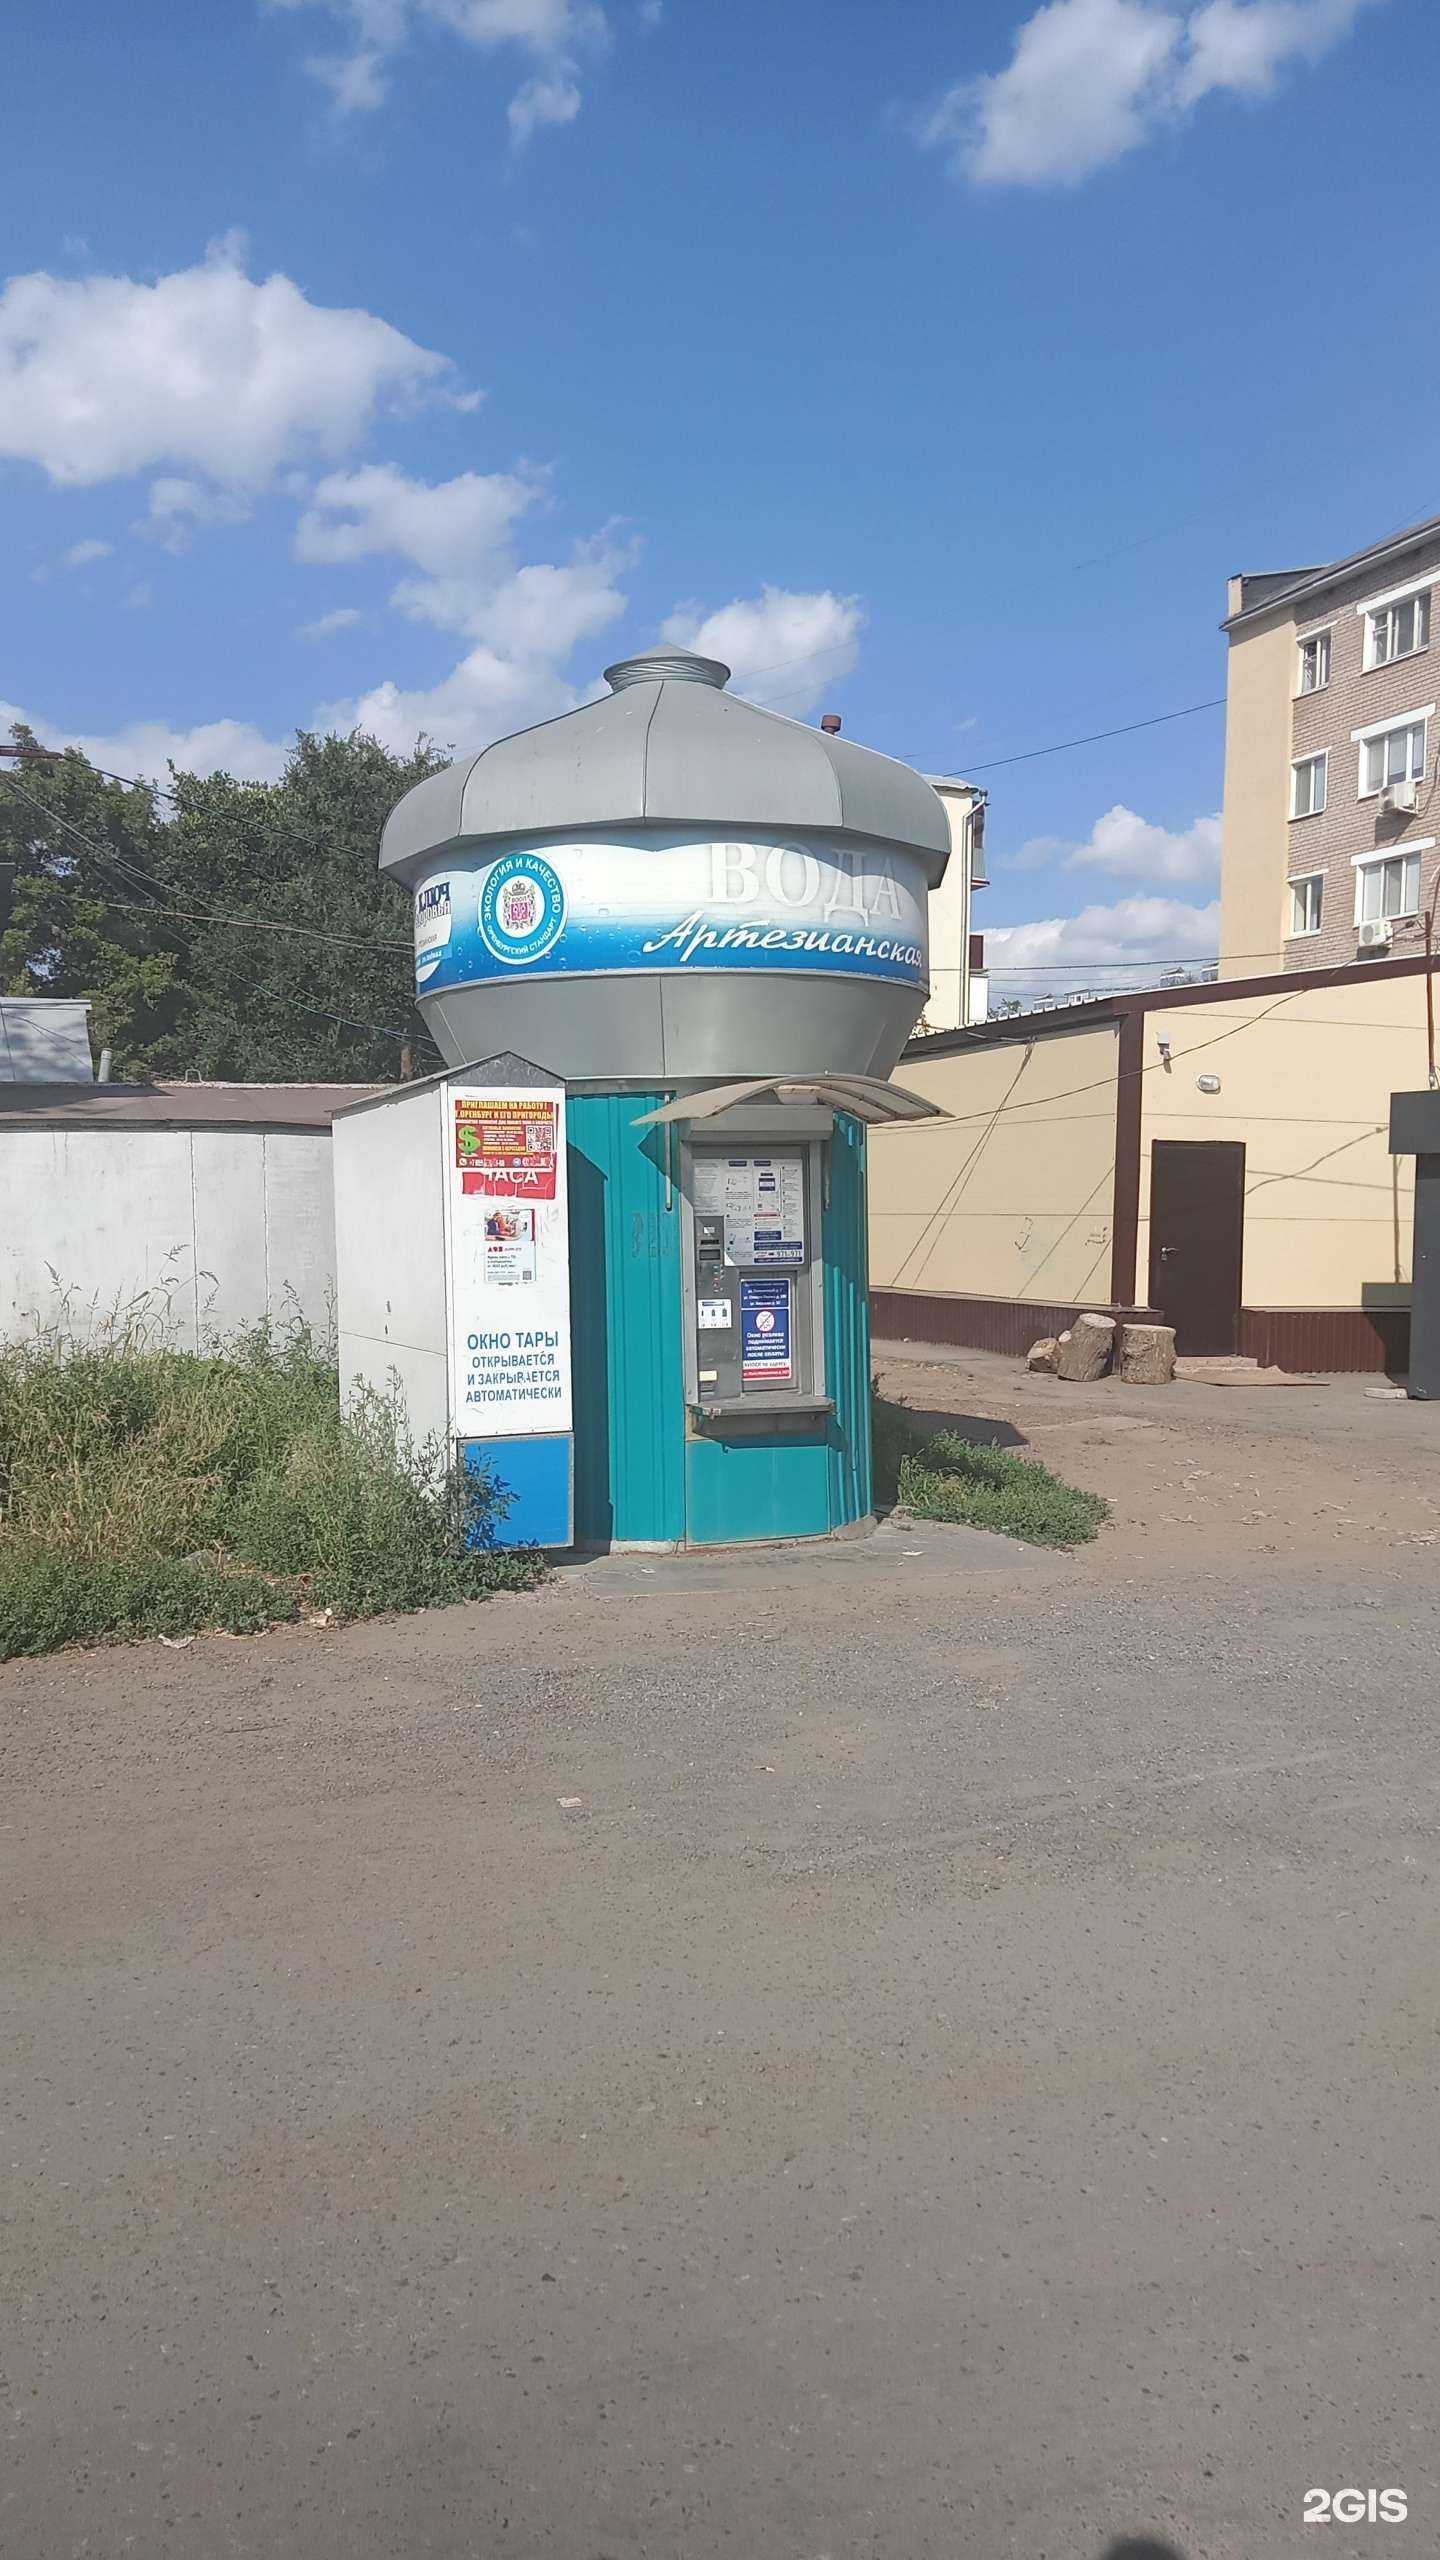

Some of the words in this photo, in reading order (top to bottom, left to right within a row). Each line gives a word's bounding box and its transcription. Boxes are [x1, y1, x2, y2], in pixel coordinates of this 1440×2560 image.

[484, 860, 513, 922] ЭКОЛОГИЯ
[515, 858, 523, 868] И
[525, 857, 561, 914] КАЧЕСТВО
[703, 841, 902, 928] ВОДА
[643, 910, 922, 969] Артезианская
[467, 1332, 511, 1350] ОКНО
[515, 1330, 559, 1348] ТАРЫ
[472, 1353, 555, 1369] ОТКРЫВАЕТСЯ
[467, 1373, 475, 1386] И
[478, 1370, 560, 1385] ЗАКРЫВАЕТСЯ
[465, 1386, 562, 1404] АВТОМАТИЧЕСКИ
